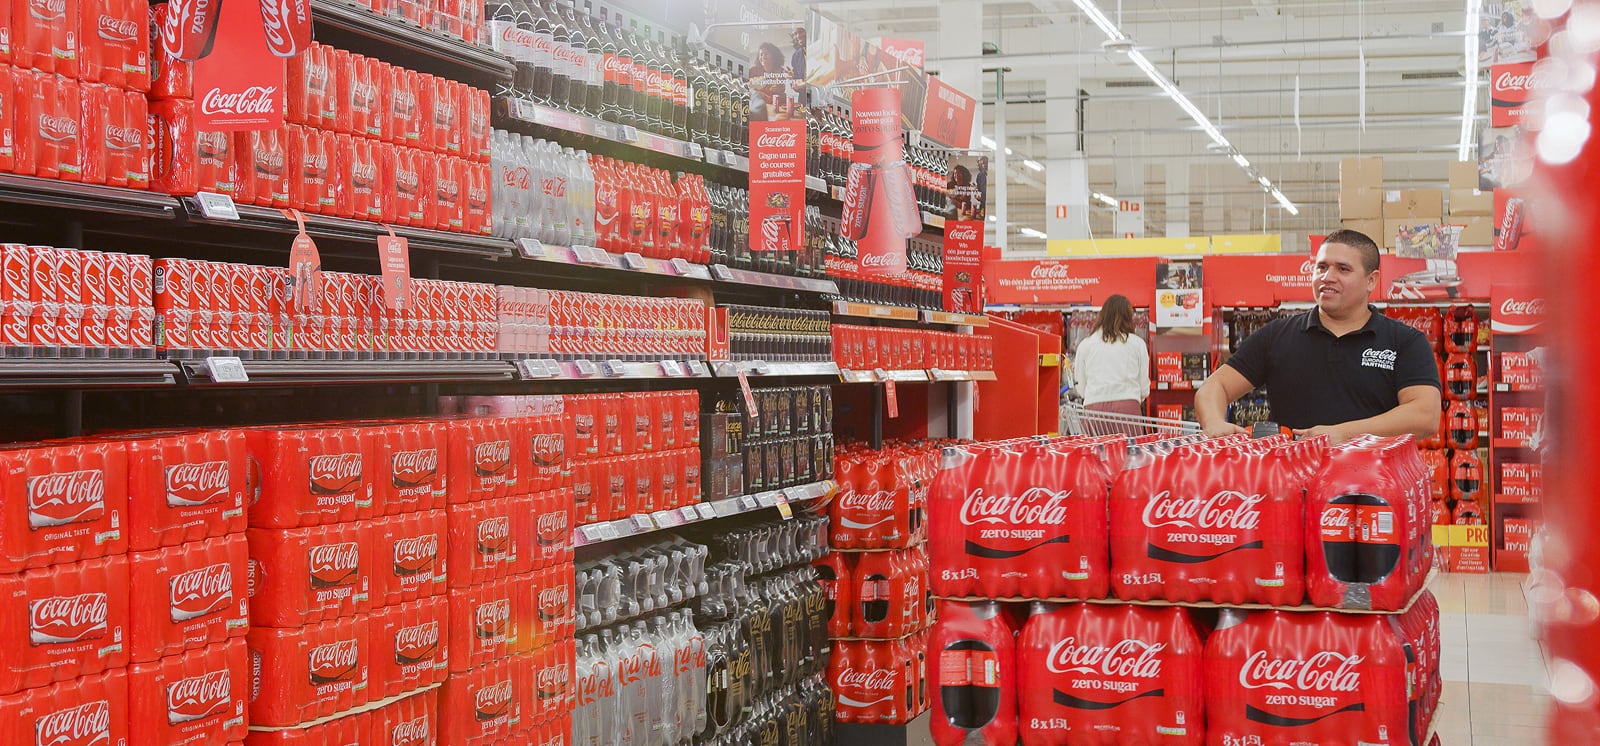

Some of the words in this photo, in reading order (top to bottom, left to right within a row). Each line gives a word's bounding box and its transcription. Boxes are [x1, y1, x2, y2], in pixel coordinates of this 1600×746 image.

[98, 14, 138, 37] Coca-Cola
[202, 86, 277, 115] Coca-Cola
[757, 133, 798, 148] Coca-Cola
[950, 229, 978, 240] Coca-Cola
[1031, 264, 1069, 278] Coca-Cola
[1361, 362, 1394, 370] PARTNERS
[1362, 348, 1397, 361] Coca-Cola
[312, 453, 362, 480] Coca-Cola
[393, 448, 437, 474] Coca-Cola
[29, 469, 104, 510] Coca-Cola
[167, 461, 229, 499] Coca-Cola
[317, 496, 334, 506] zero
[335, 494, 355, 505] sugar
[840, 490, 897, 510] Coca-Cola
[960, 487, 1072, 526] Coca-Cola
[1142, 490, 1267, 530] Coca-Cola
[44, 531, 72, 541] ORIGINAL
[74, 528, 90, 536] TASTE
[980, 529, 1009, 539] zero
[1011, 529, 1045, 541] sugar
[1167, 532, 1198, 543] zero
[1199, 533, 1236, 545] sugar
[311, 542, 358, 573] Coca-Cola
[395, 534, 437, 563] Coca-Cola
[171, 562, 232, 605] Coca-Cola
[317, 592, 332, 602] zero
[333, 587, 352, 600] sugar
[33, 593, 107, 629] Coca-Cola
[396, 621, 438, 652] Coca-Cola
[47, 647, 75, 655] ORIGINAL
[310, 639, 358, 671] Coca-Cola
[1046, 637, 1168, 678] Coca-Cola
[837, 668, 899, 690] Coca-Cola
[1239, 650, 1366, 692] Coca-Cola
[169, 669, 230, 708] Coca-Cola
[317, 686, 333, 696] zero
[334, 681, 352, 693] sugar
[1072, 679, 1101, 689] zero
[1103, 681, 1139, 693] sugar
[1265, 695, 1296, 705] zero
[1299, 696, 1338, 708] sugar
[37, 701, 109, 742] Coca-Cola
